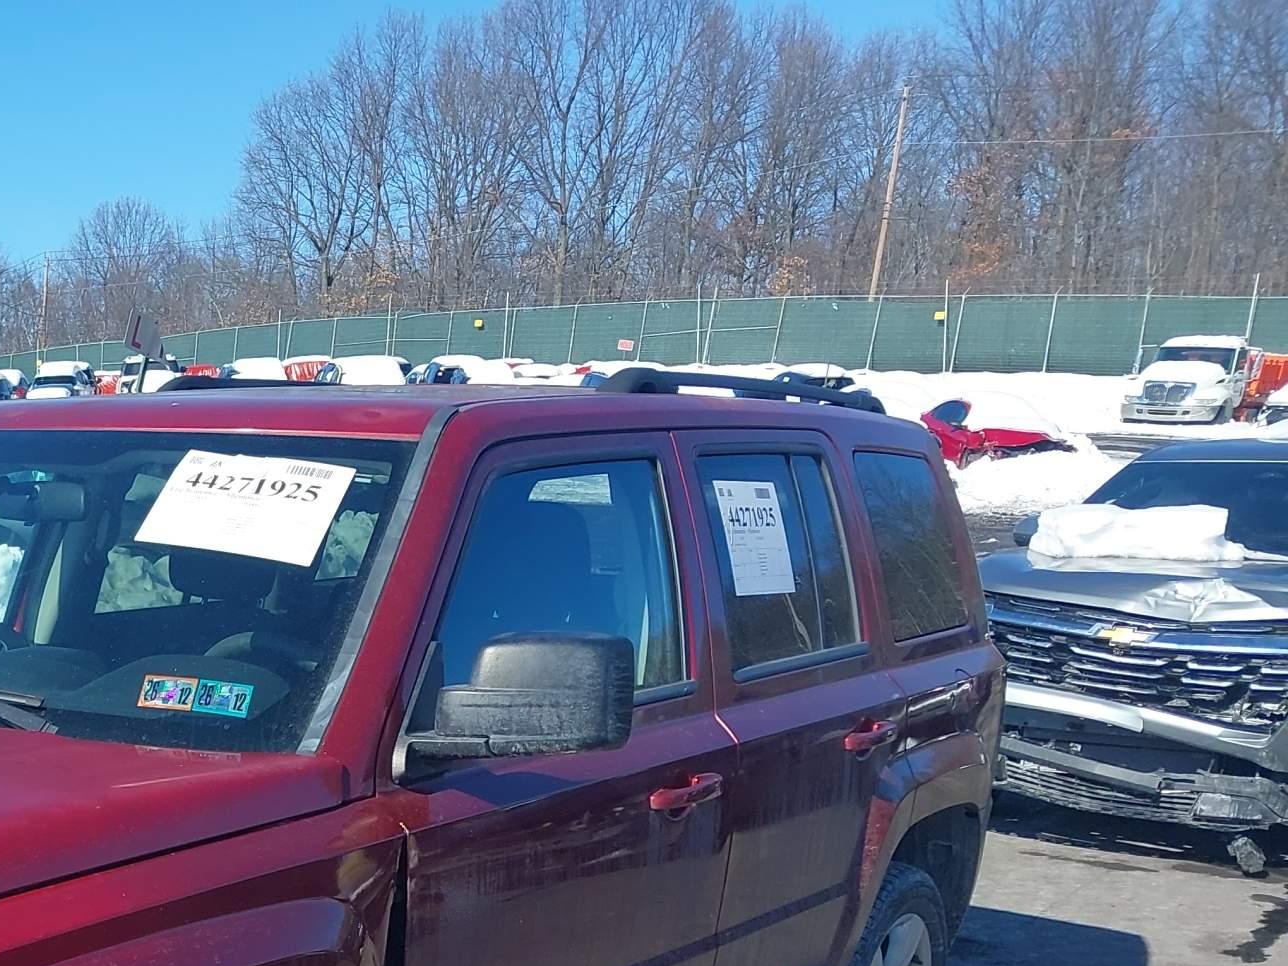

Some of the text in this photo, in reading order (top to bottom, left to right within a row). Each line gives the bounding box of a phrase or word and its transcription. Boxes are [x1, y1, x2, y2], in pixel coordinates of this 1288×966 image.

[185, 471, 322, 503] 44271925
[728, 505, 776, 527] 44271925
[144, 680, 192, 705] 26 12
[198, 684, 247, 711] 26 12
